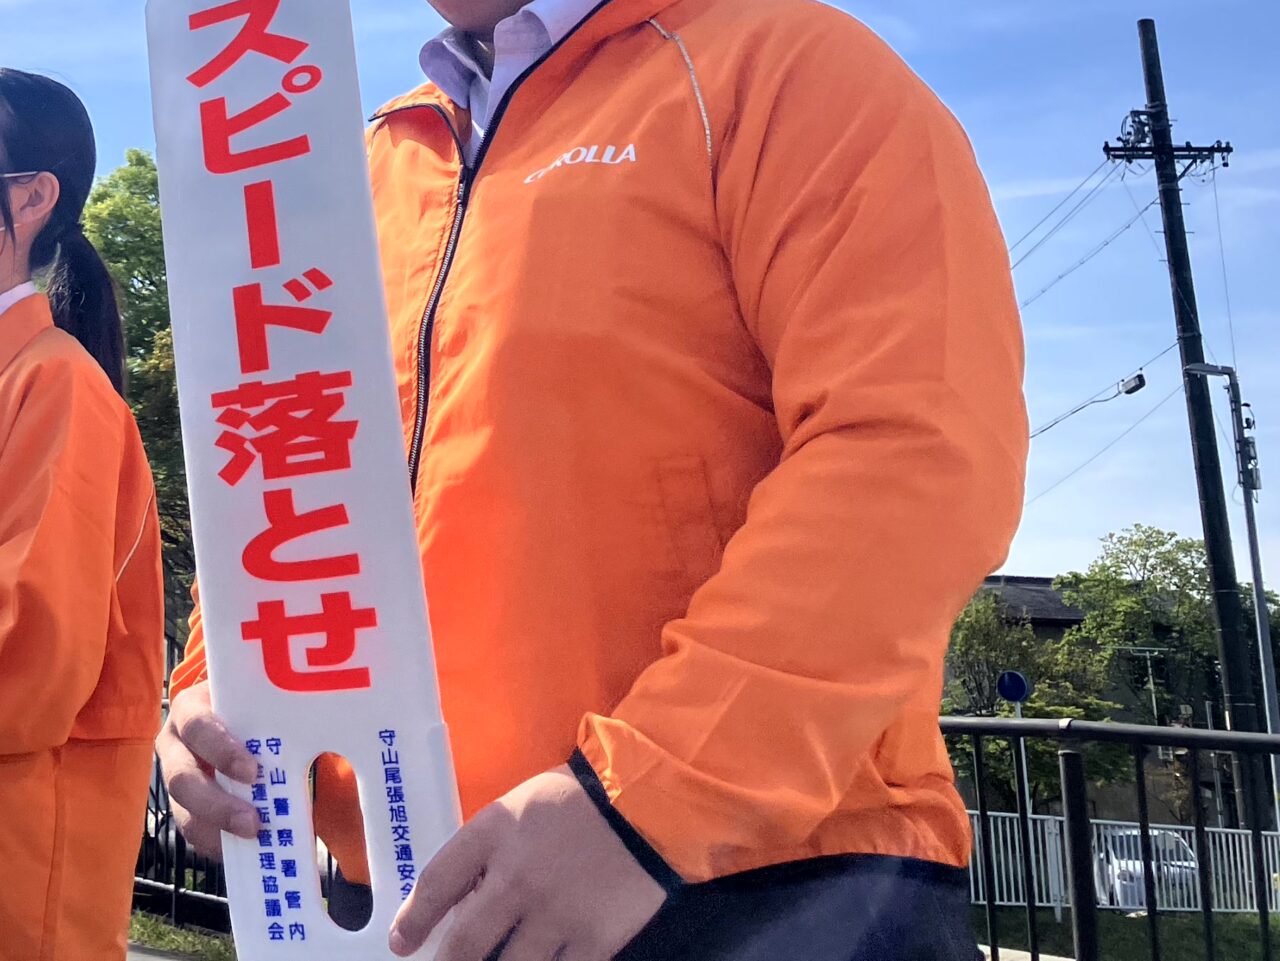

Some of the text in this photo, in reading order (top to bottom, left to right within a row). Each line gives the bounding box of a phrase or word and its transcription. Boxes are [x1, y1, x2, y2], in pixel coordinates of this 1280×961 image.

[266, 737, 306, 941] 守山警察署管内
